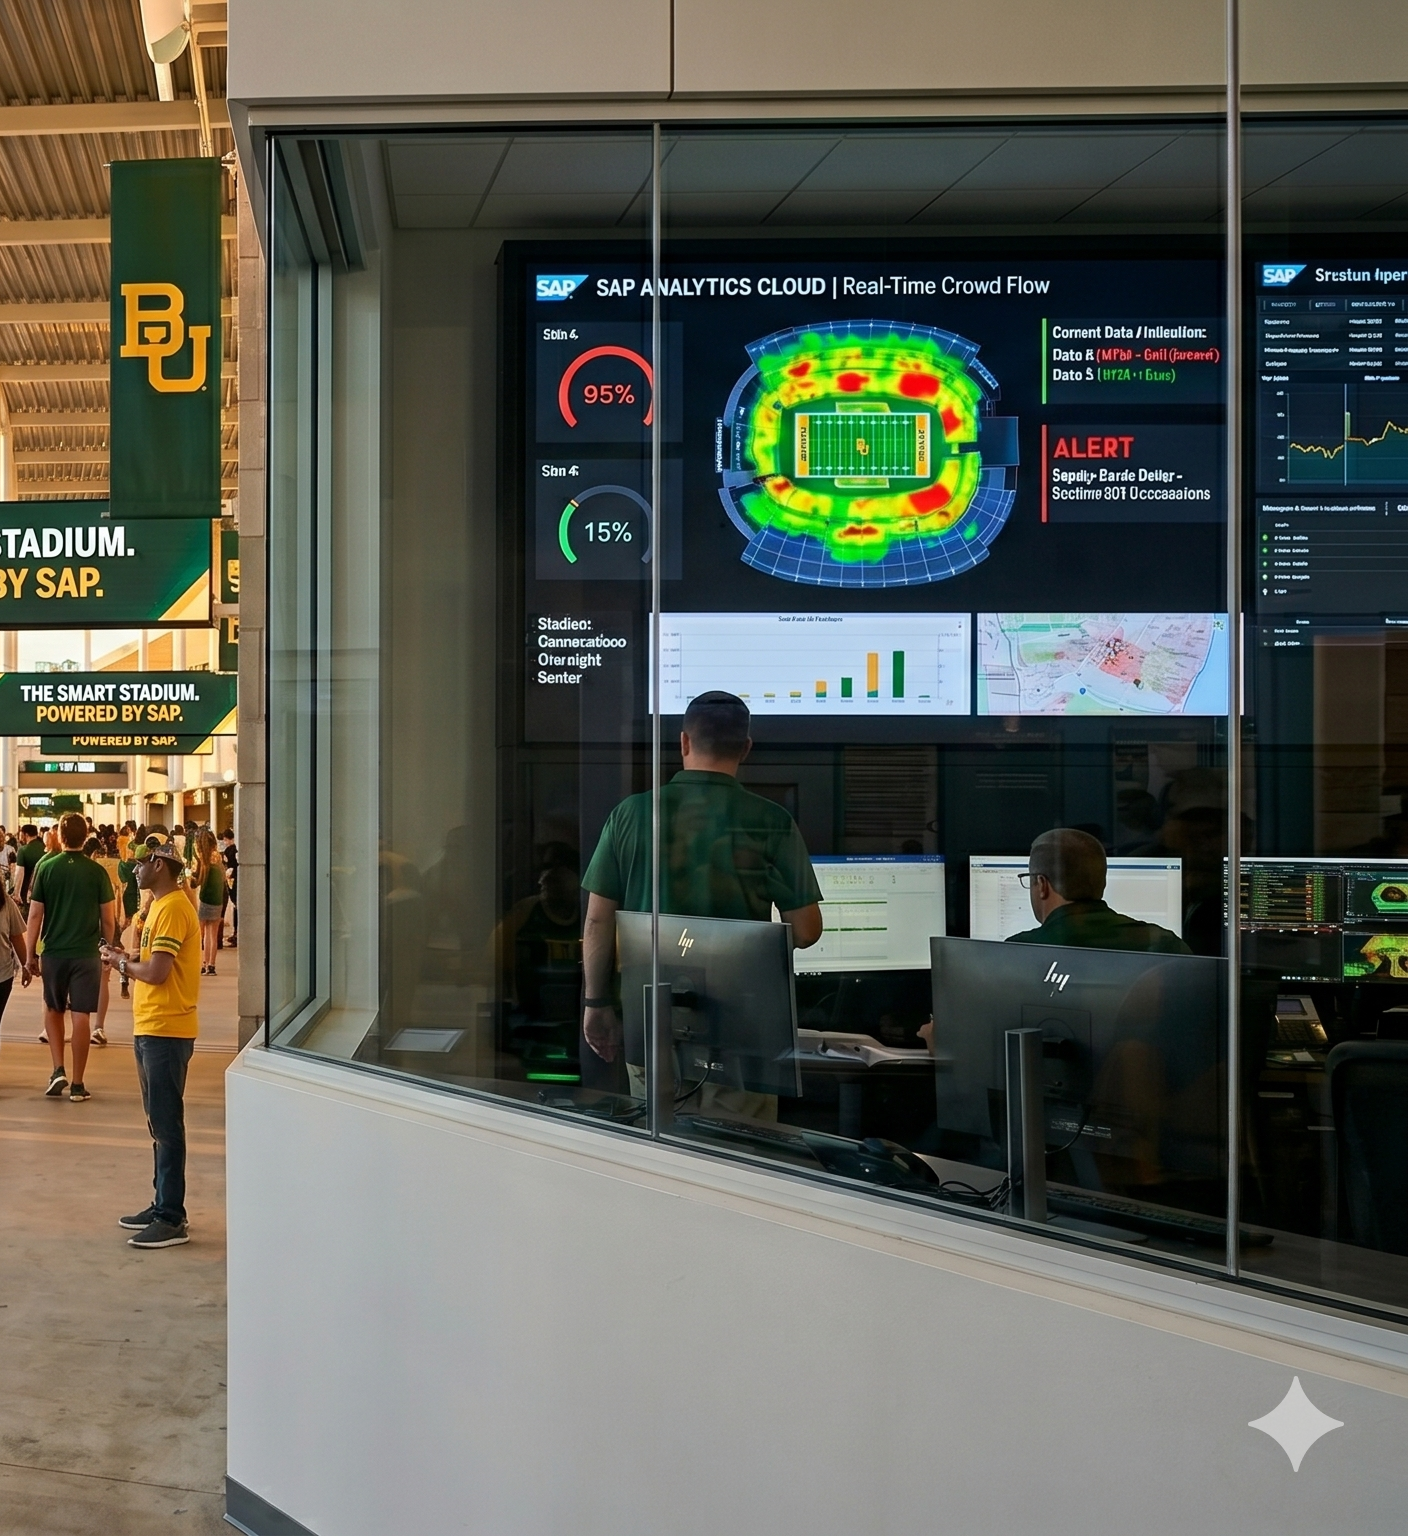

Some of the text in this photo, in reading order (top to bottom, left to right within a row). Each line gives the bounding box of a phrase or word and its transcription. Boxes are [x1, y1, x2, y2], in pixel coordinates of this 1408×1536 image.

[1263, 268, 1297, 284] SAP
[536, 280, 577, 297] SAP
[596, 279, 636, 297] SAP
[640, 278, 752, 297] ANALYTICS
[757, 277, 826, 296] CLOUD
[843, 276, 937, 296] Real-Time
[941, 275, 1001, 295] Crowd
[1007, 275, 1050, 294] Flow
[120, 283, 211, 393] BU
[1105, 326, 1133, 339] Data
[584, 384, 635, 404] 95%
[1053, 436, 1135, 459] ALERT
[584, 521, 633, 542] 15%
[35, 566, 105, 599] SAP.
[537, 670, 583, 684] Senter
[20, 683, 200, 702] THE SMART STADIUM.
[36, 704, 184, 722] POWERED BY SAP.
[72, 736, 178, 746] POWERED BY SAP.
